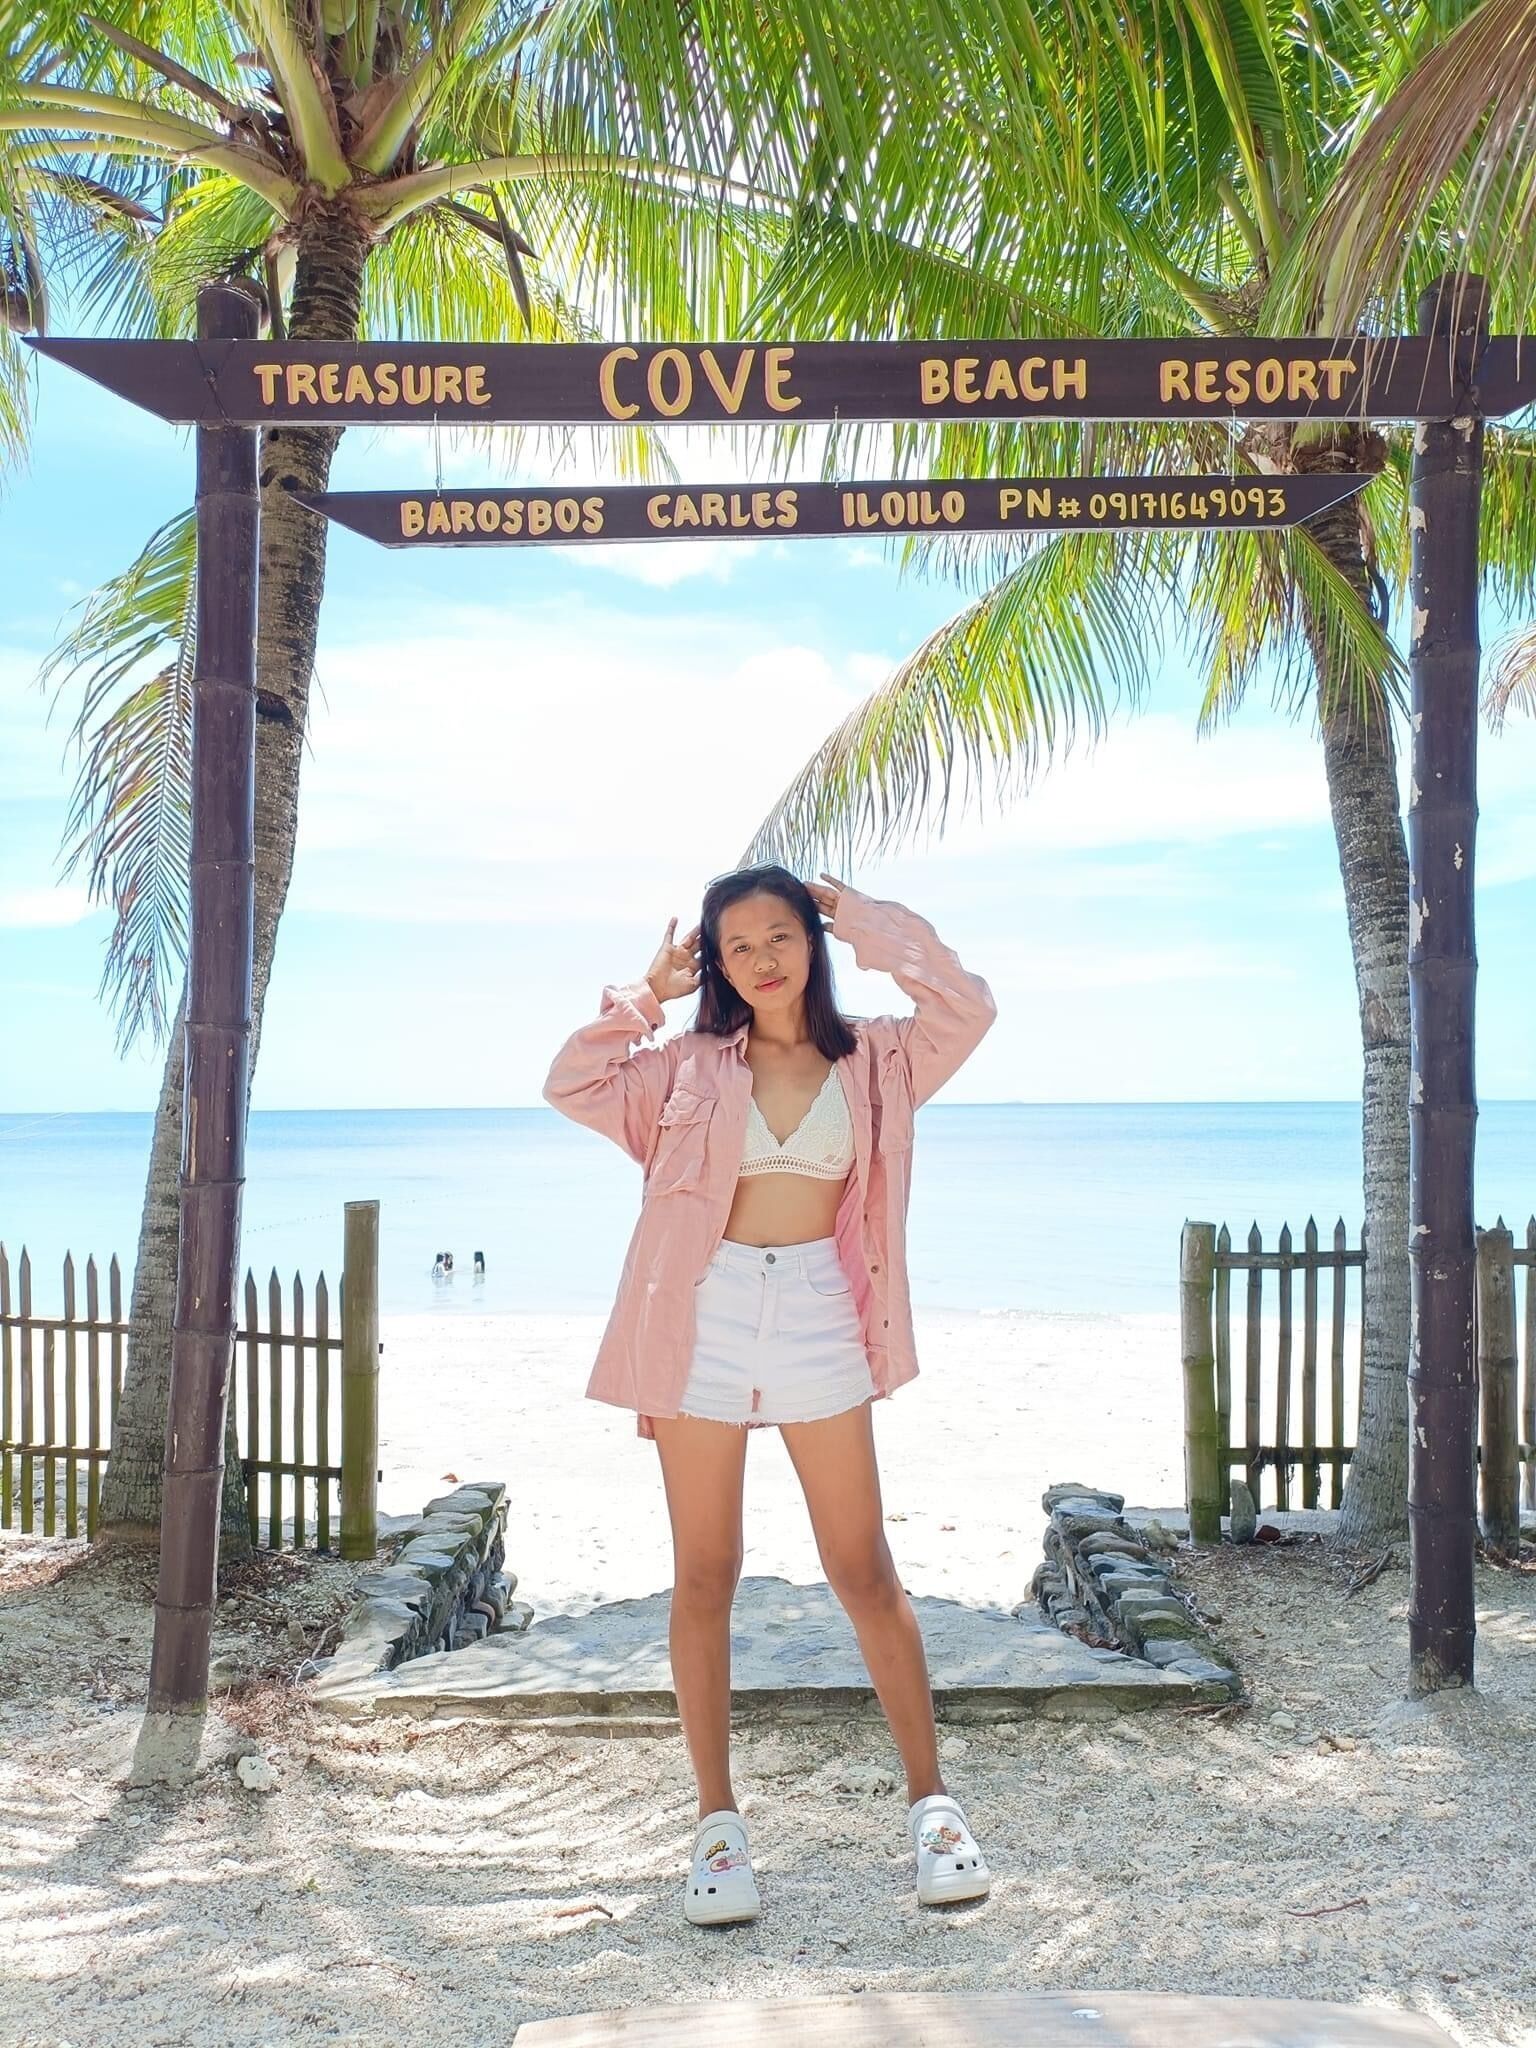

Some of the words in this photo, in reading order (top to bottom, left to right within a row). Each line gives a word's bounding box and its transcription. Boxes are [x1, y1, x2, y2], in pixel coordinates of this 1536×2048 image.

[253, 363, 492, 405] TREASURE
[599, 347, 803, 421] COVE
[919, 356, 1088, 405] BEACH
[1159, 358, 1357, 404] RESORT
[399, 495, 605, 538] BAROSBOS
[646, 490, 800, 529] CARLES
[841, 490, 966, 527] ILOILO
